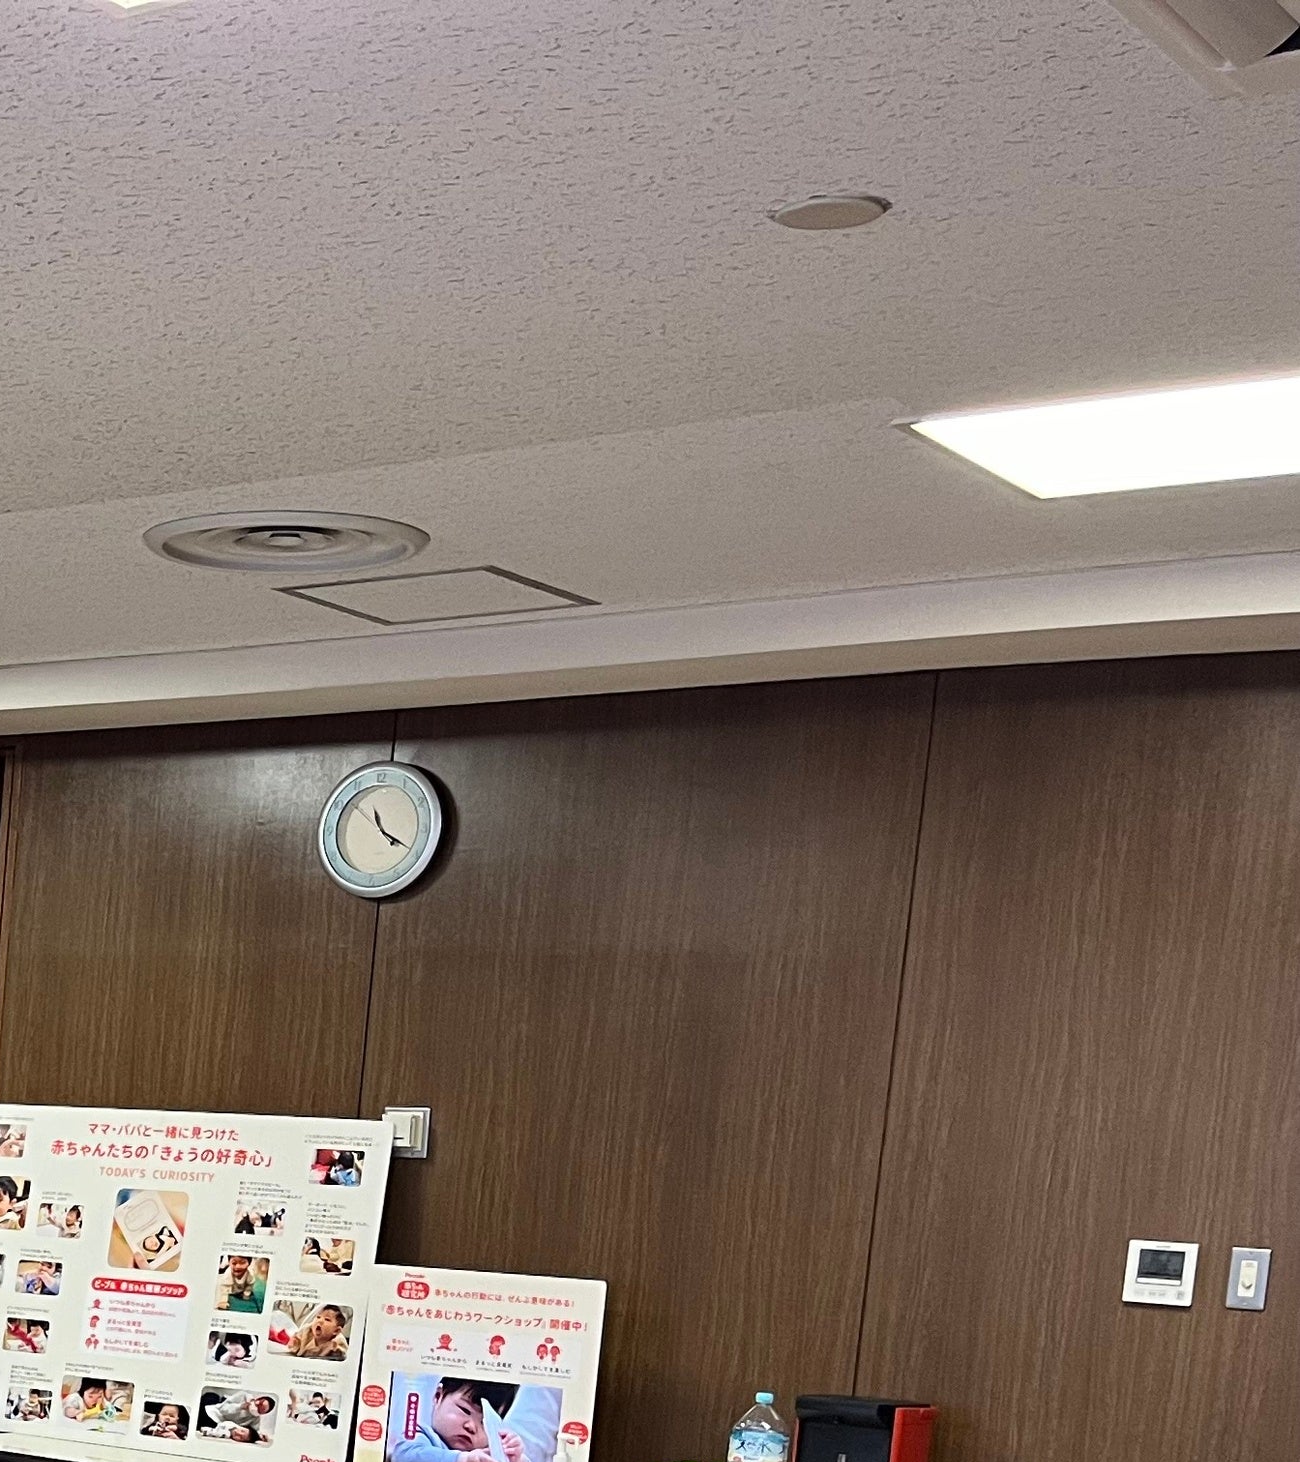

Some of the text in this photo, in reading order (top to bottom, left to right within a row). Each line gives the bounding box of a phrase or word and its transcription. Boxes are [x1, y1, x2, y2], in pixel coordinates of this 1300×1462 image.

[88, 1123, 239, 1142] ママ・パパと一緒に見つけた
[50, 1139, 273, 1168] 赤ちゃんたちの「きょうの好奇心」
[99, 1165, 215, 1183] TODAY'S CURIOSITY
